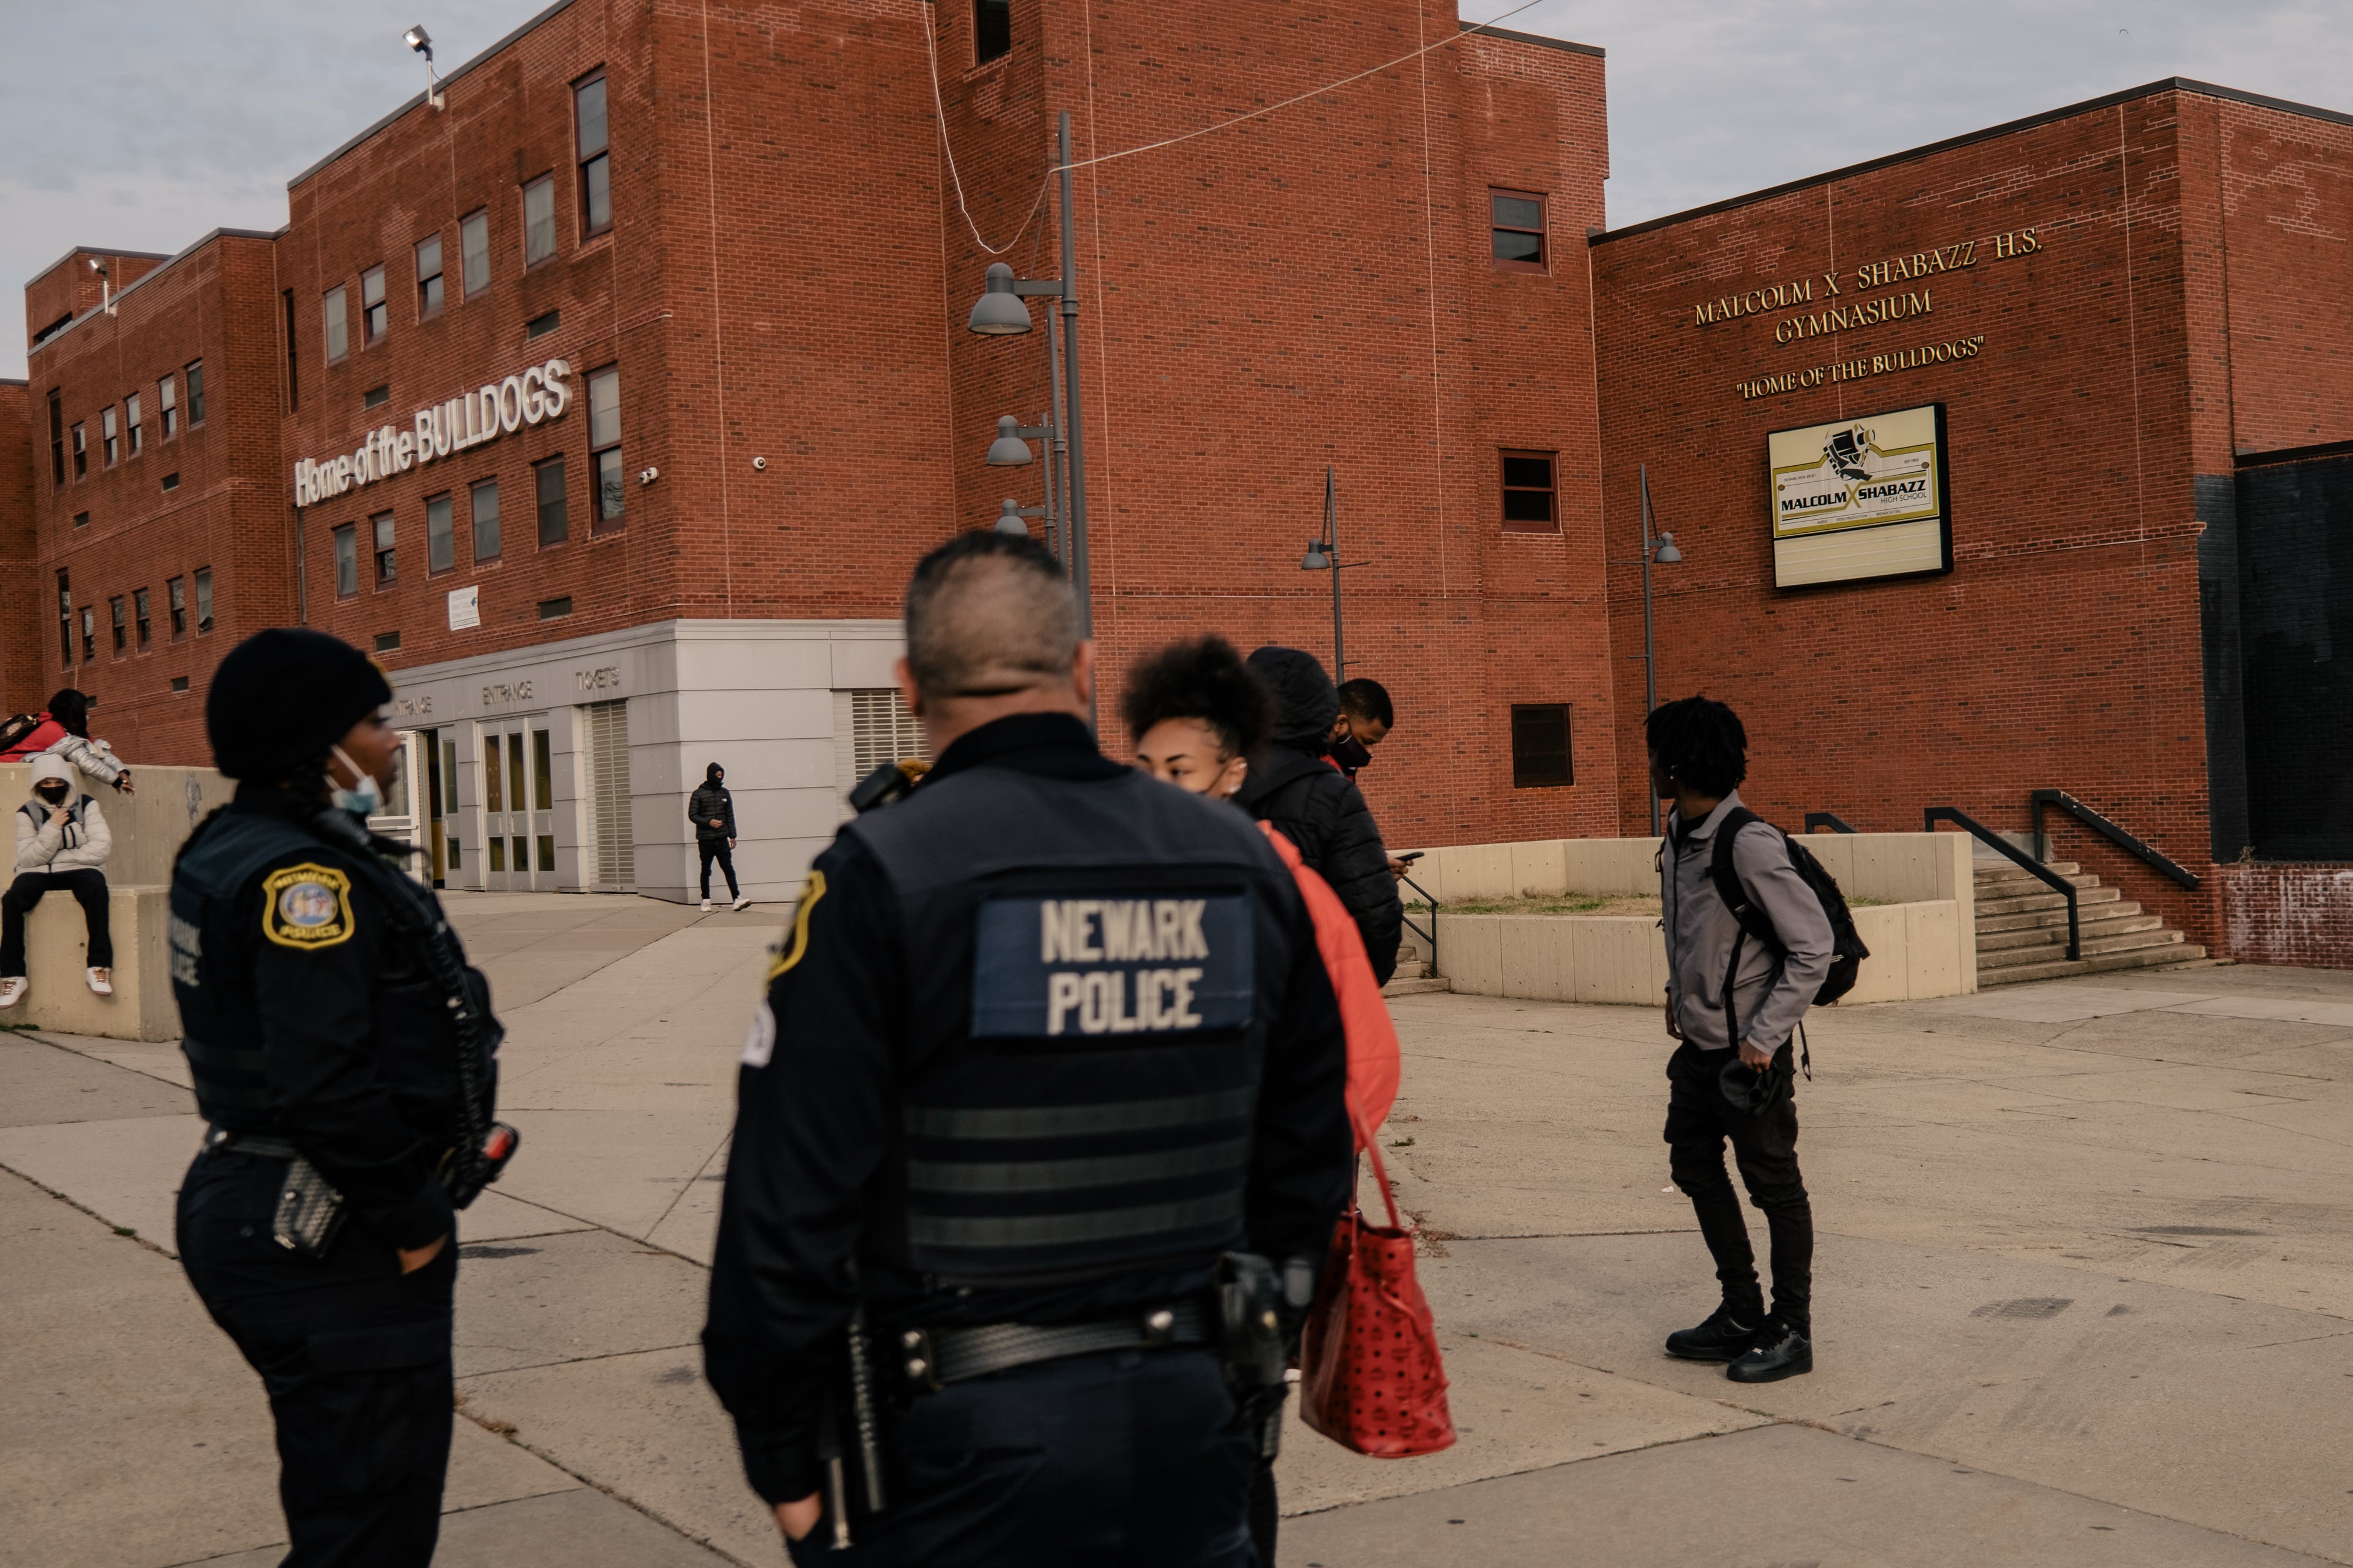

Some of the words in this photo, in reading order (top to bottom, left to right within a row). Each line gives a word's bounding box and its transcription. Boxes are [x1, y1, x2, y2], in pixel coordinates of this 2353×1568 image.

[1695, 279, 1813, 326] MALCOLM
[1823, 272, 1841, 296] X
[1858, 241, 1977, 289] SHABAZZ
[1994, 228, 2043, 259] H.S.
[1776, 289, 1933, 343] GYMNASIUM
[1737, 372, 1797, 399] "HOME
[1801, 367, 1825, 387] OF
[1828, 359, 1868, 382] THE
[1872, 336, 1984, 375] BULLDOGS"
[295, 458, 356, 506] Home
[355, 431, 380, 485] of
[379, 425, 417, 475] the
[416, 359, 572, 462] BULLDOGS
[1782, 492, 1847, 511] MALCOLM
[1858, 479, 1926, 500] SHABAZZ
[1899, 492, 1927, 502] SCHOOL
[482, 680, 533, 705] ENTRANCE
[576, 666, 619, 691] TICKETS
[395, 696, 432, 716] NTRANCE
[1041, 899, 1209, 963] NEWARK
[1046, 968, 1203, 1035] POLICE
